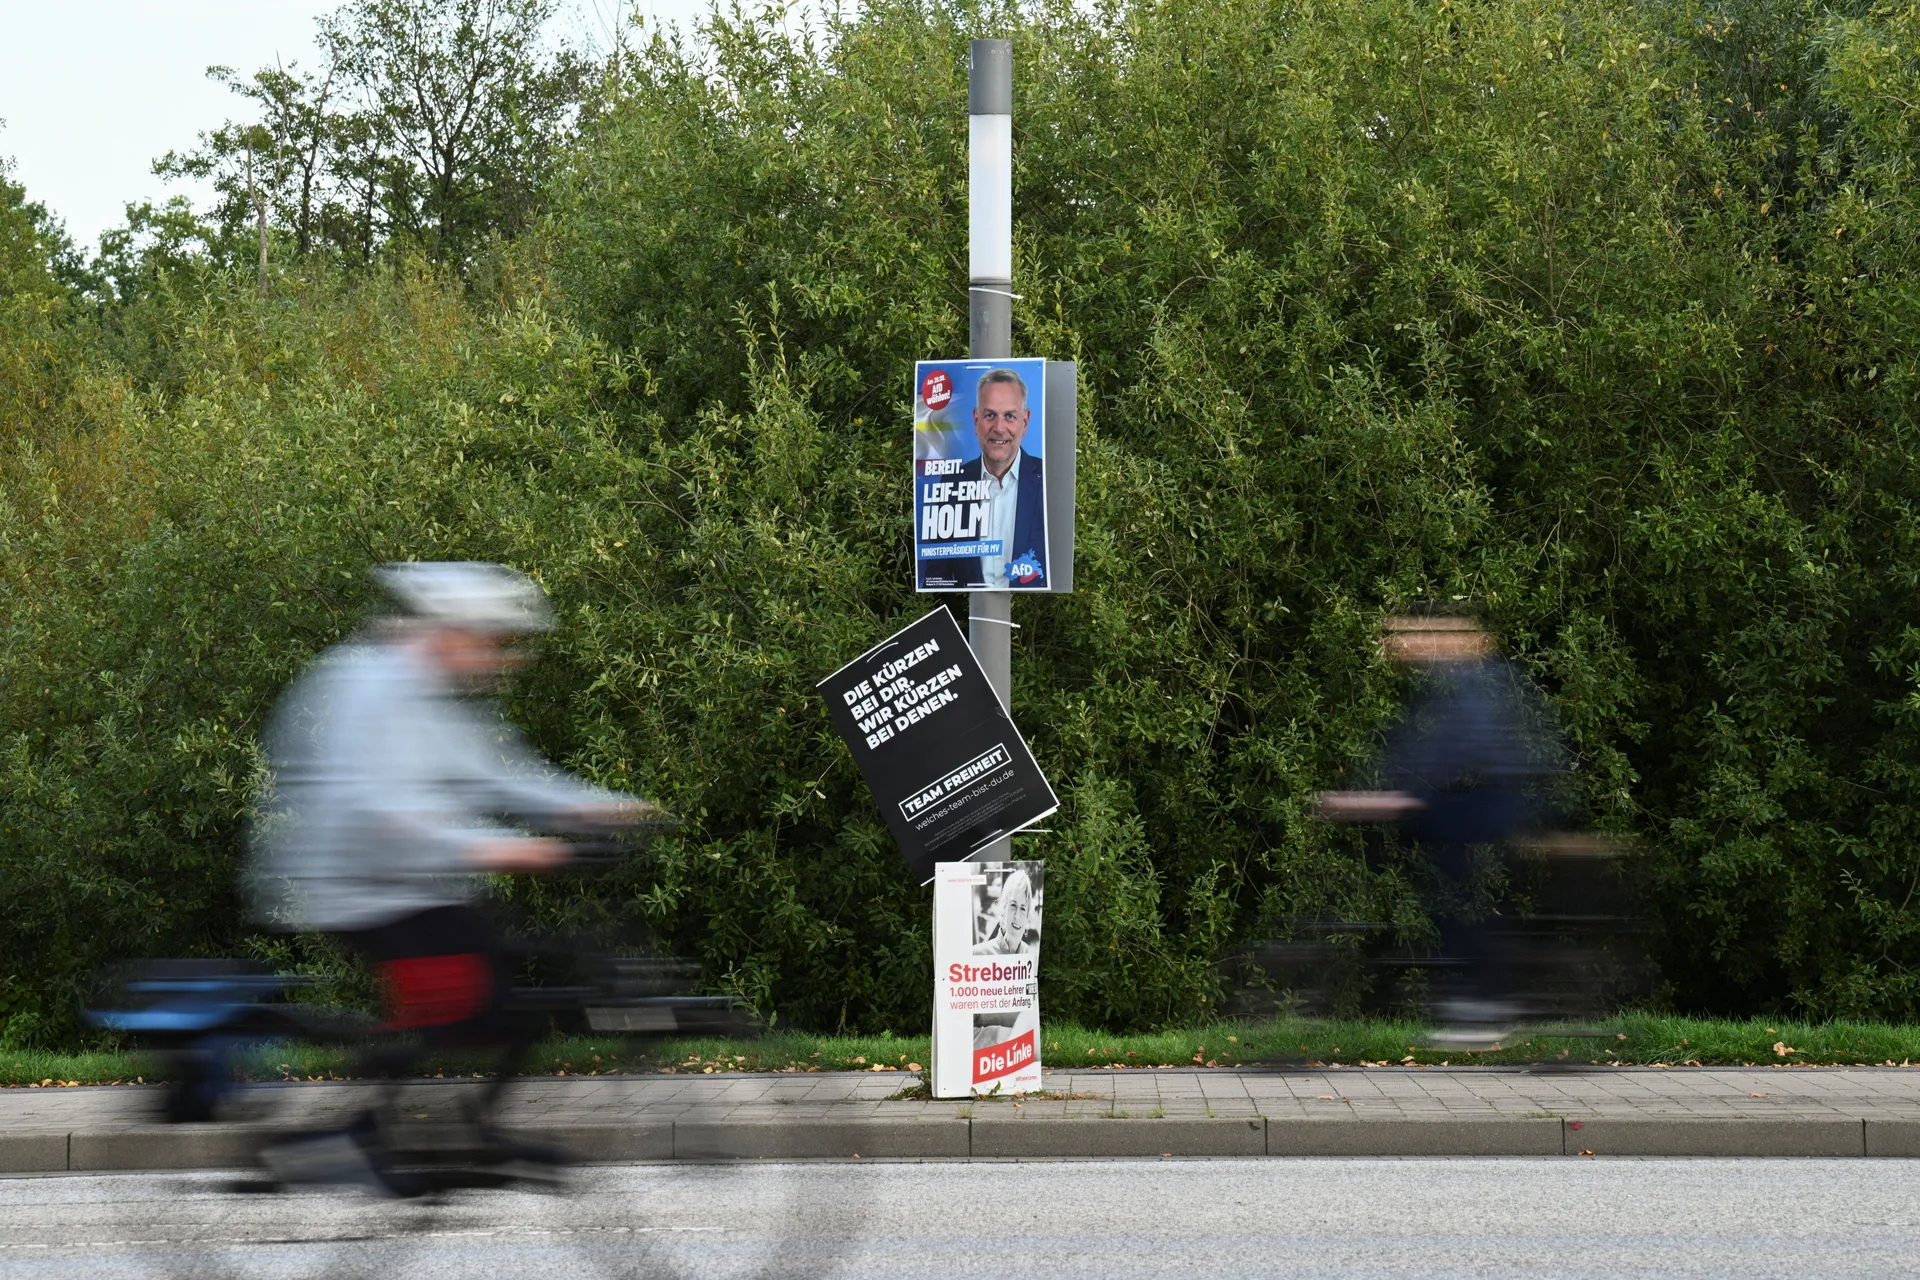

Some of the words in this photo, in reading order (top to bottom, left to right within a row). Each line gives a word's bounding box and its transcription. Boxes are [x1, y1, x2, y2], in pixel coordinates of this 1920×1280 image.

[926, 390, 951, 405] wählen!
[932, 383, 943, 394] AfD
[924, 459, 964, 476] BEREIT.
[923, 480, 992, 503] LEIF-ERIK
[921, 502, 990, 540] HOLM
[921, 544, 977, 557] MINISTERPRÄSIDENT
[977, 543, 989, 554] FÜR
[990, 544, 1000, 553] MV
[1011, 564, 1033, 576] AfD
[843, 680, 873, 706] DIE
[872, 638, 940, 687] KÜRZEN
[850, 695, 880, 720] BEI
[879, 677, 915, 702] DIR.
[858, 706, 894, 734] WIR
[893, 664, 963, 713] KÜRZEN
[866, 724, 895, 750] BEI
[895, 688, 958, 732] DENEN.
[905, 785, 944, 814] TEAM
[944, 750, 1004, 791] FREIHEIT
[915, 768, 1015, 831] welches-team-bist-du.de
[949, 960, 1032, 983] Streberin?
[949, 987, 979, 997] 1.000
[980, 986, 1003, 996] neue
[1004, 985, 1025, 995] Lehrer
[949, 1001, 979, 1010] waren
[980, 1000, 998, 1009] erst
[998, 999, 1012, 1008] der
[980, 1053, 1005, 1076] Die
[1006, 1042, 1032, 1068] Linke
